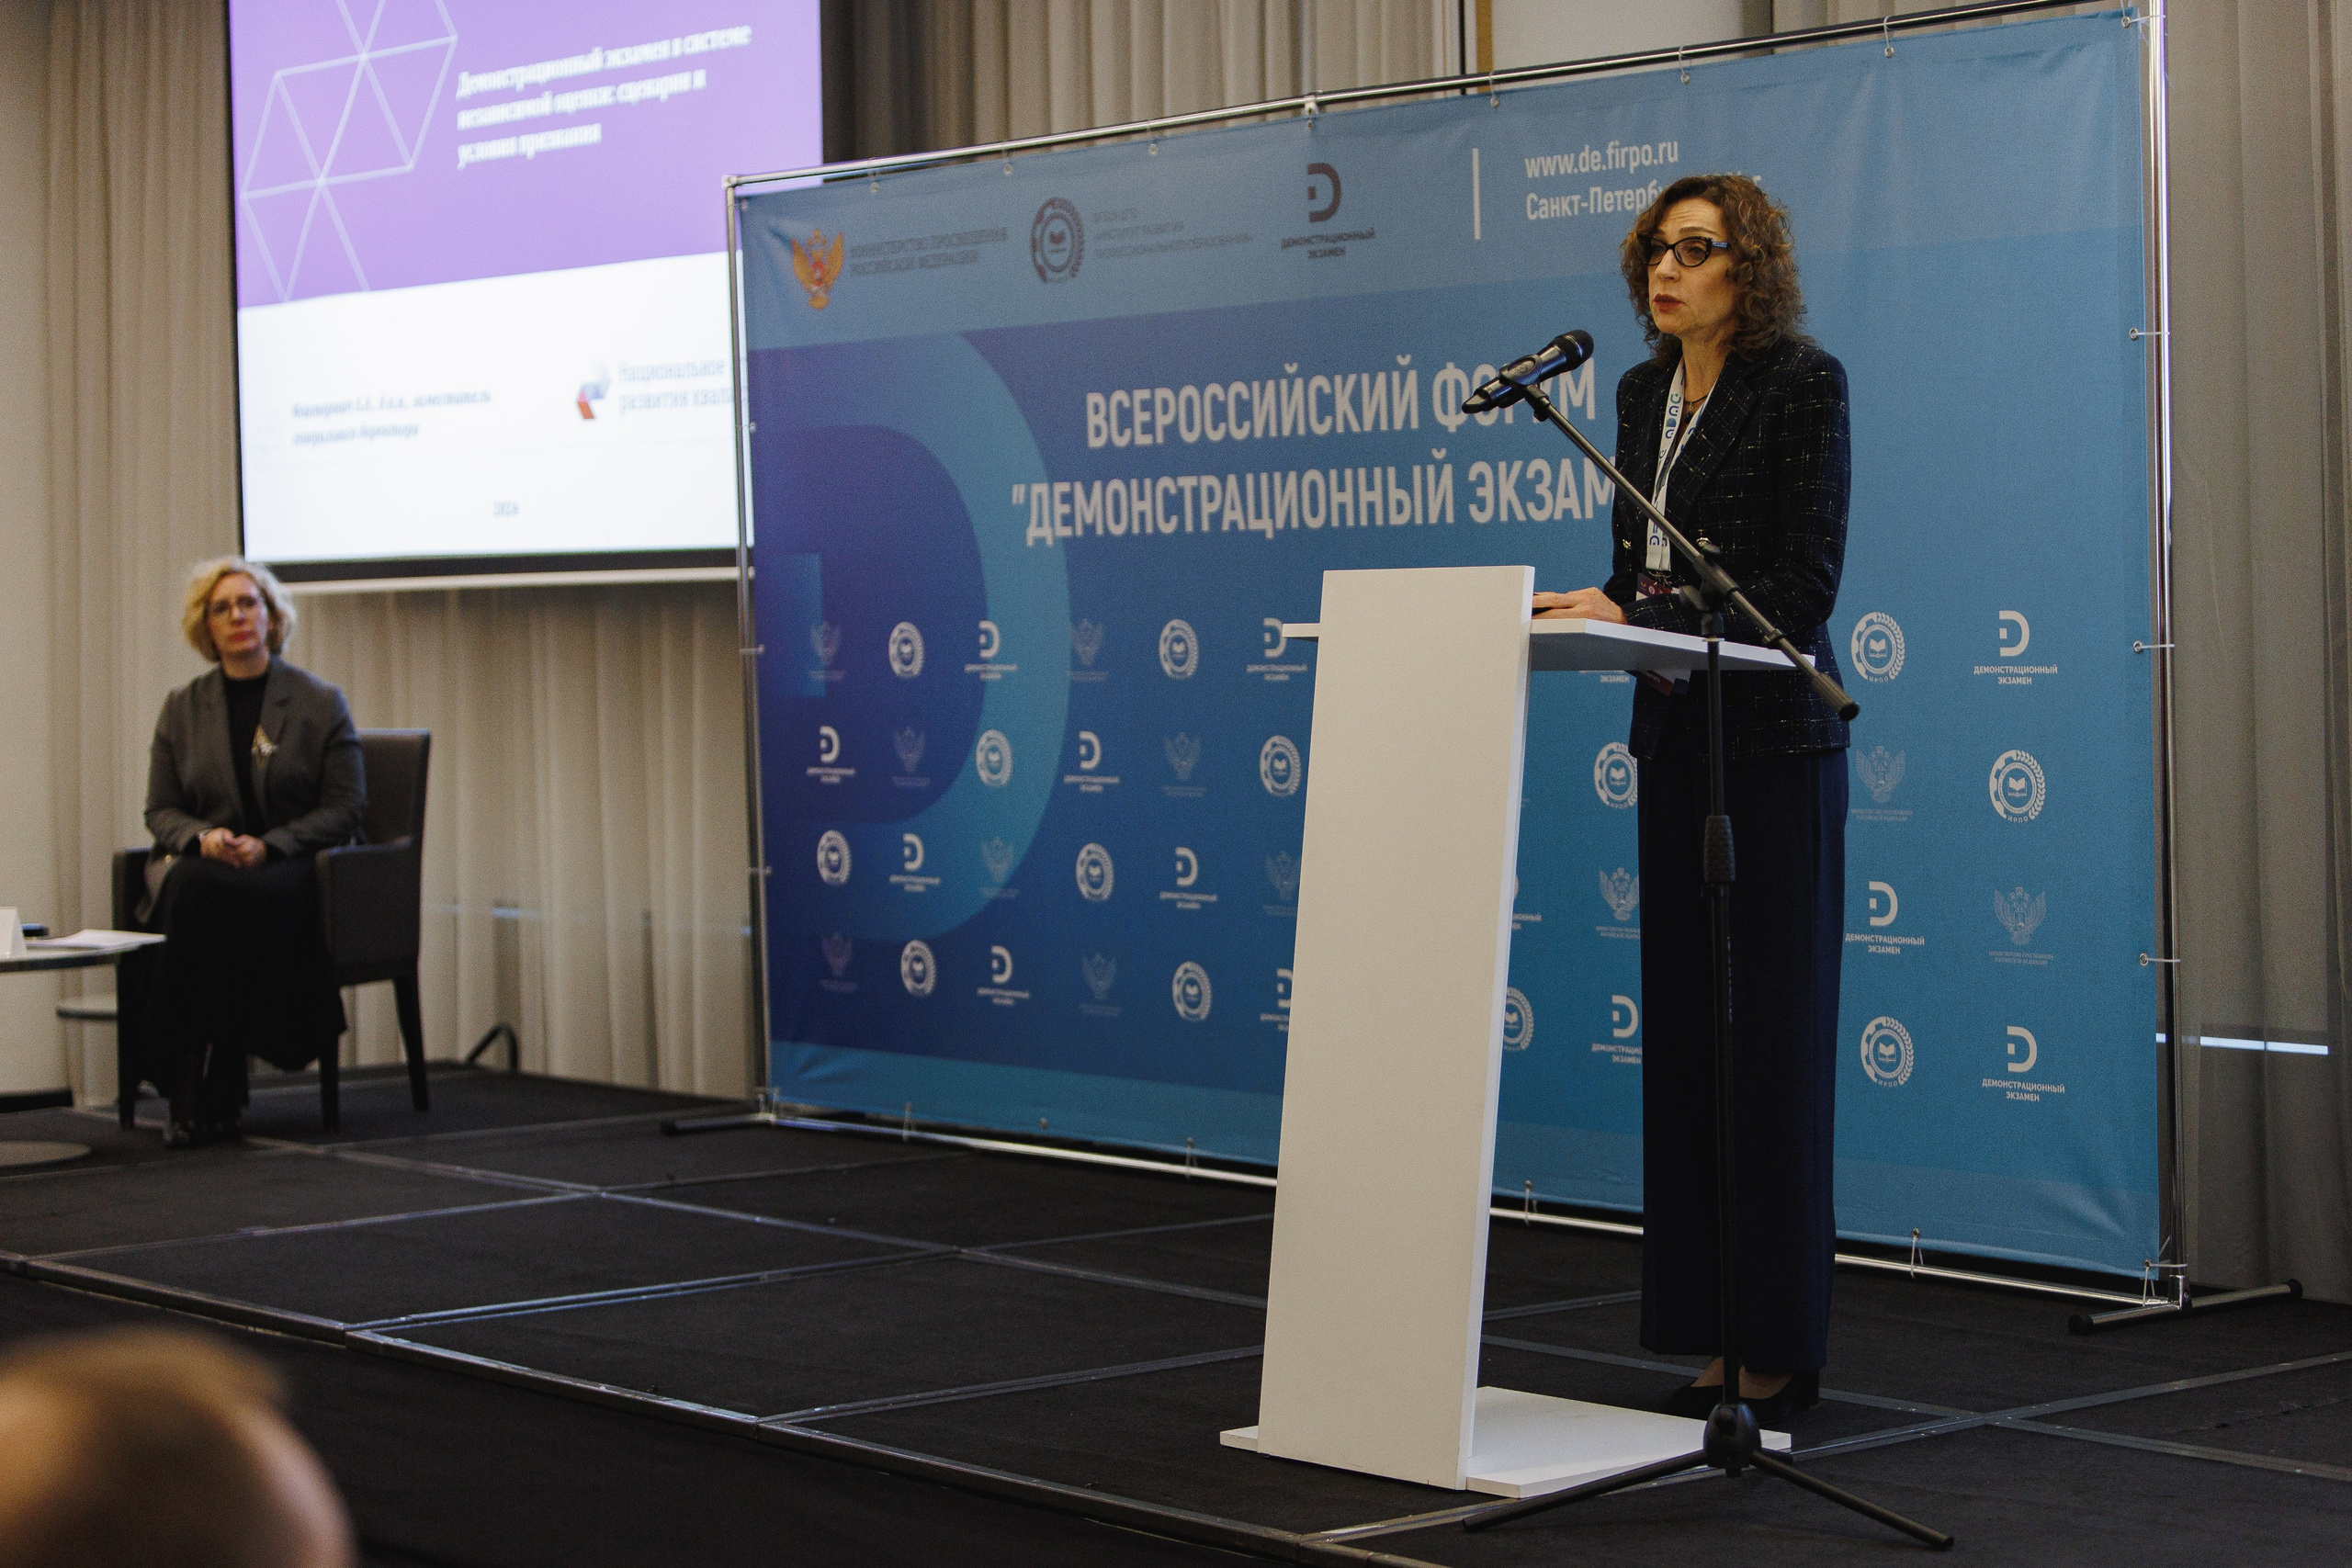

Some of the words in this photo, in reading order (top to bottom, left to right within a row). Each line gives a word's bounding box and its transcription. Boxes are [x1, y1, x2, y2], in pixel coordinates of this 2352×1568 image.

[683, 24, 752, 55] системе
[1524, 140, 1679, 178] www.de.firpo.ru
[1525, 178, 1662, 220] Санкт-Петерб
[1086, 354, 1419, 448] ВСЕРОССИЙСКИЙ
[1431, 357, 1597, 433] ФОМ
[1012, 447, 1454, 547] "ДЕМОНСТРАЦИОННЫЙ
[1973, 663, 2058, 675] ДЕМОНСТРАЦИОННЫЙ
[1997, 676, 2032, 685] ЭКЗАМЕН
[1845, 932, 1925, 946] ДЕМОНСТРАЦИОННЫЙ
[1868, 944, 1901, 954] ЭКЗАМЕН
[1982, 1077, 2065, 1094] ДЕМОНСТРАЦИОННЫЙ
[2006, 1091, 2040, 1102] ЭКЗАМЕН
